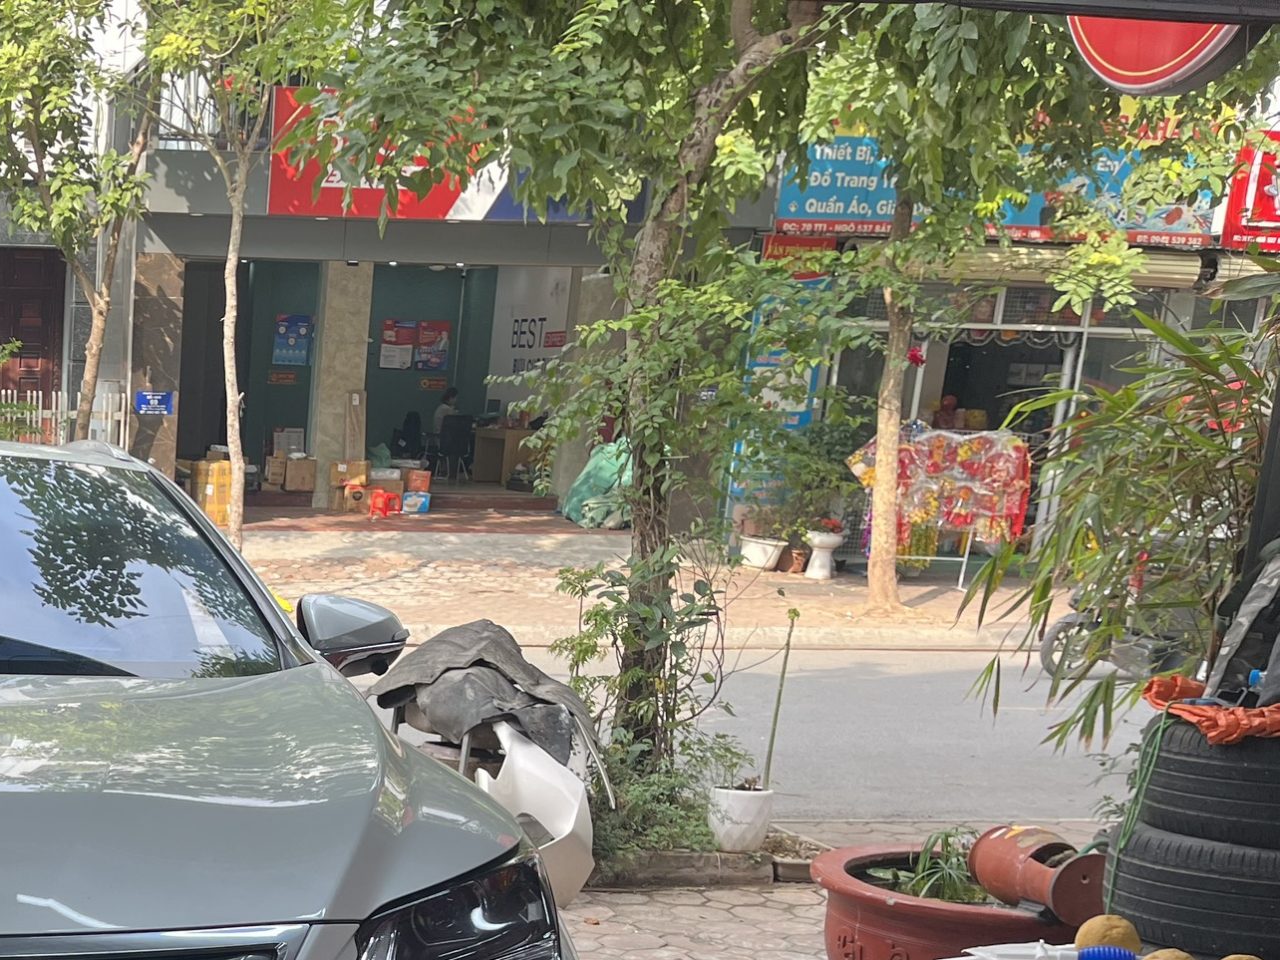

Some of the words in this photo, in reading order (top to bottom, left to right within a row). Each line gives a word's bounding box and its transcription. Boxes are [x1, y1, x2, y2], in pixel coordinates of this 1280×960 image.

[814, 143, 852, 161] Thiết
[810, 169, 832, 187] Đồ
[835, 172, 877, 189] Trang
[511, 317, 547, 349] BEST
